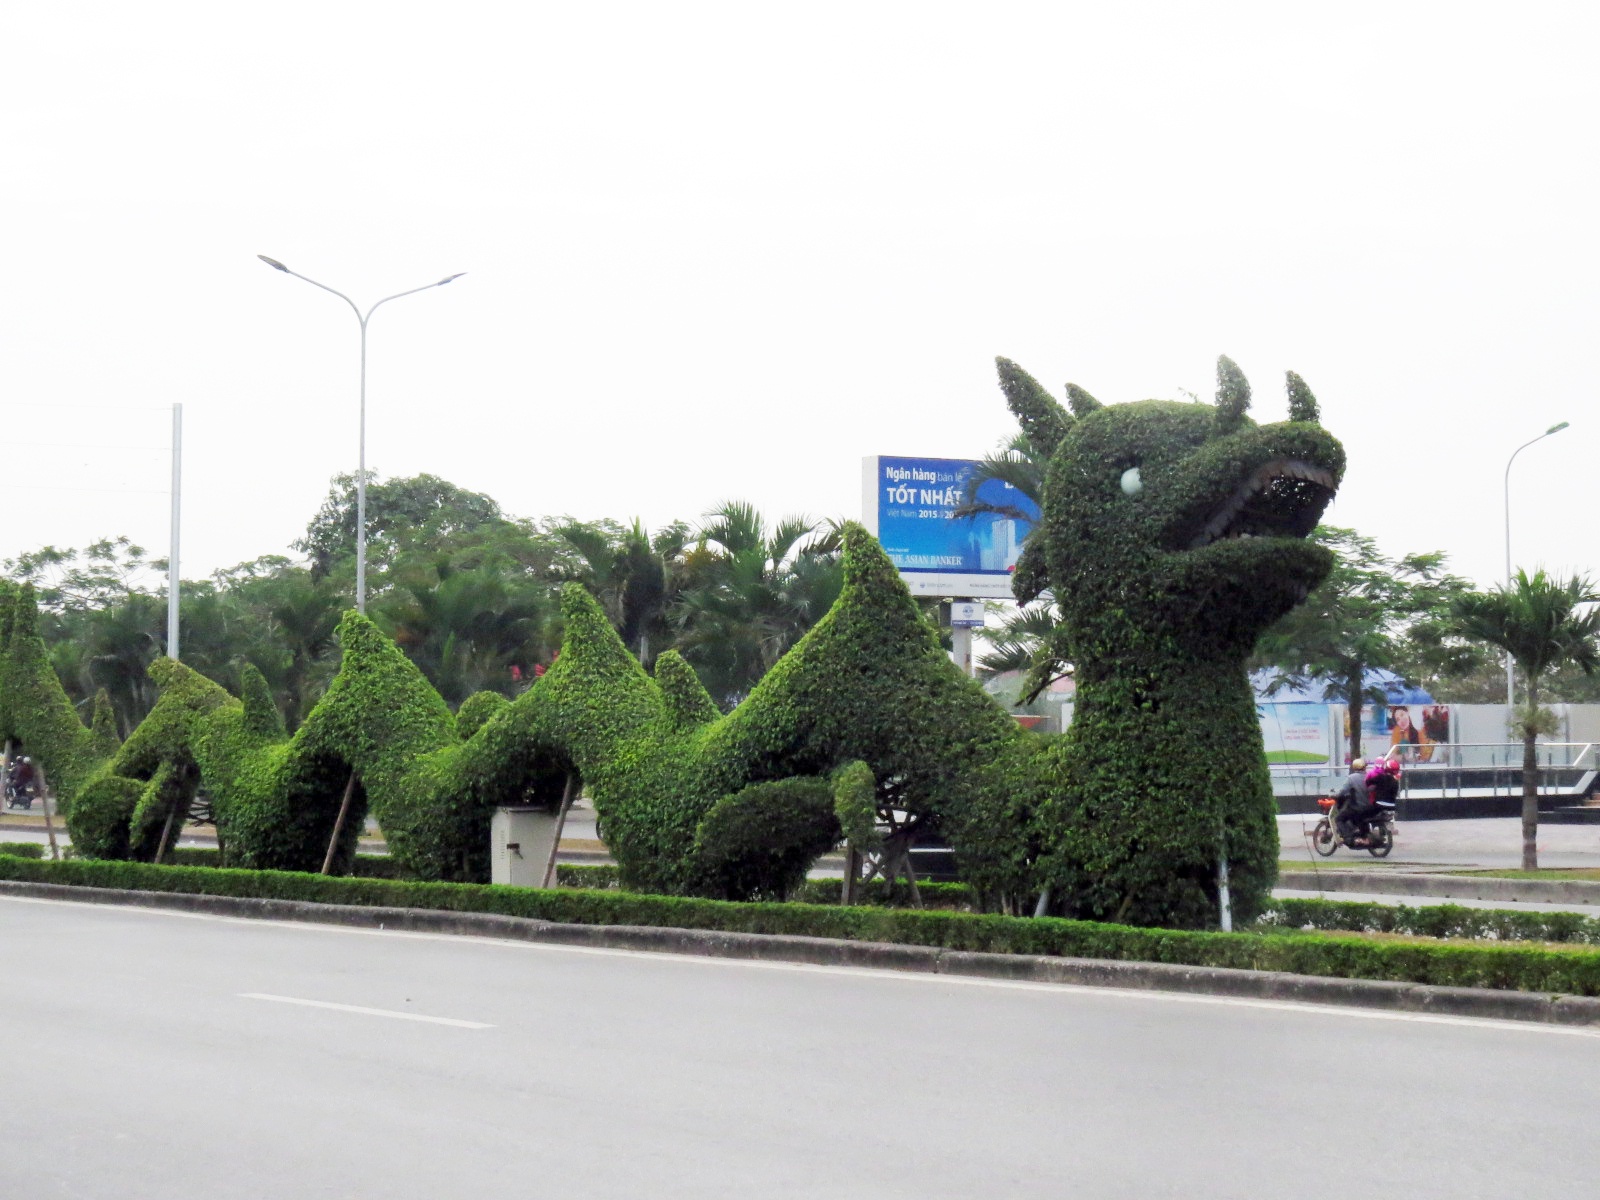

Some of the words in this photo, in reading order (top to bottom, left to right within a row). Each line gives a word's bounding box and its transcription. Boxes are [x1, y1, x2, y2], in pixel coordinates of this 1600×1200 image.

[886, 466, 911, 483] Ngân
[912, 467, 936, 484] hàng
[886, 483, 917, 504] TỐT
[920, 485, 963, 506] NHẤT
[918, 509, 938, 519] 2015
[905, 554, 929, 565] ASIAN
[930, 555, 962, 566] BANKER
